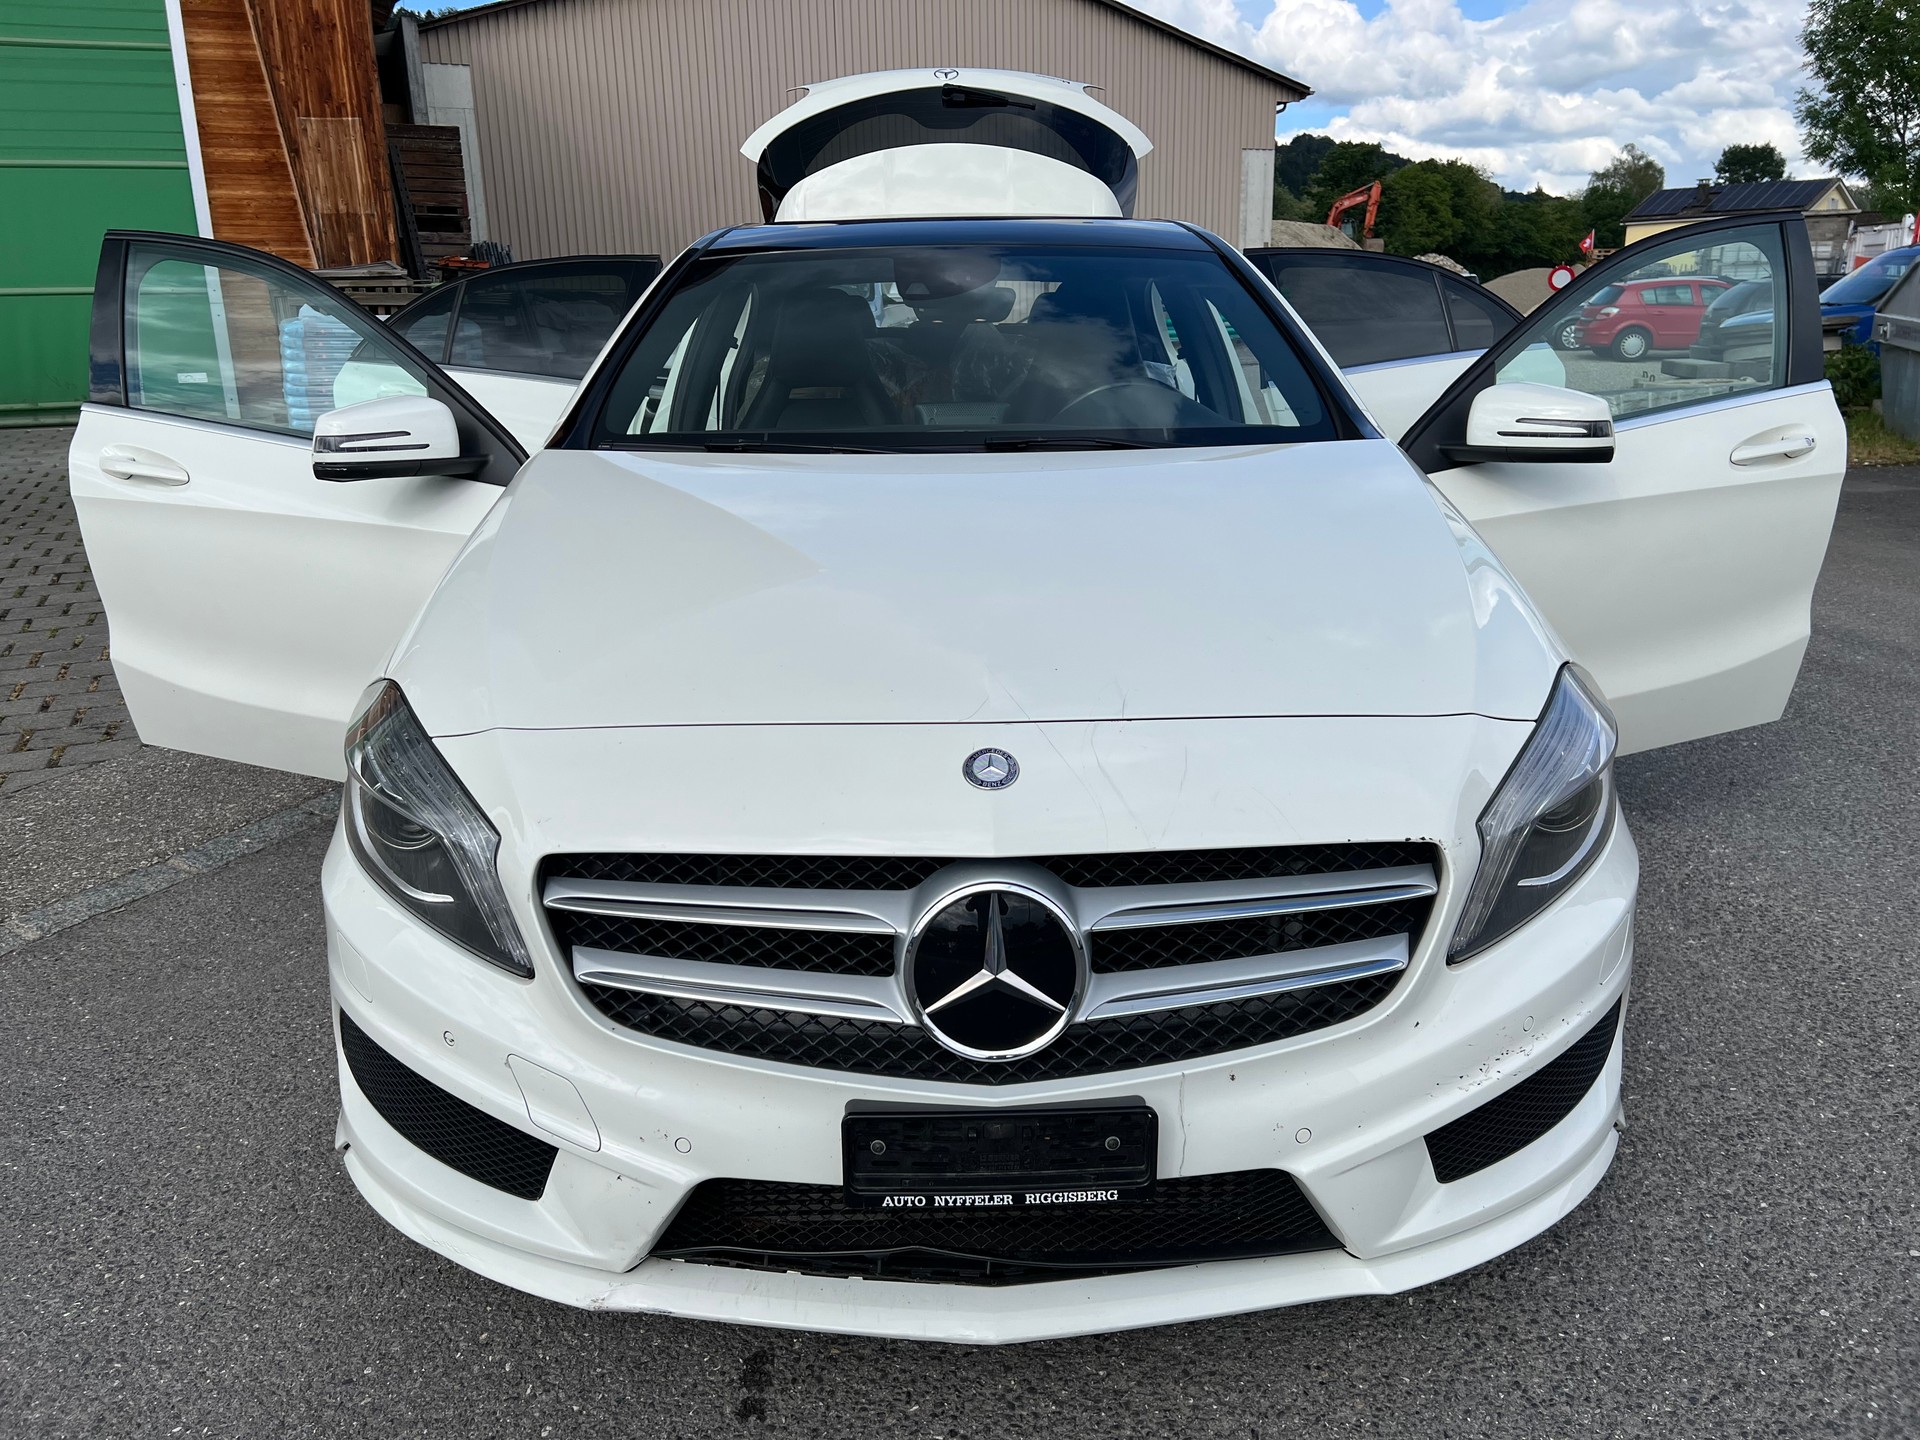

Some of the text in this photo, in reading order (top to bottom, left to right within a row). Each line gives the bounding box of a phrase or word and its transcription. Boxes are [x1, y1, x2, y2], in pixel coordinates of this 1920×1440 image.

[881, 1190, 1119, 1208] AUTO NYFFELER RIGGISBERG
